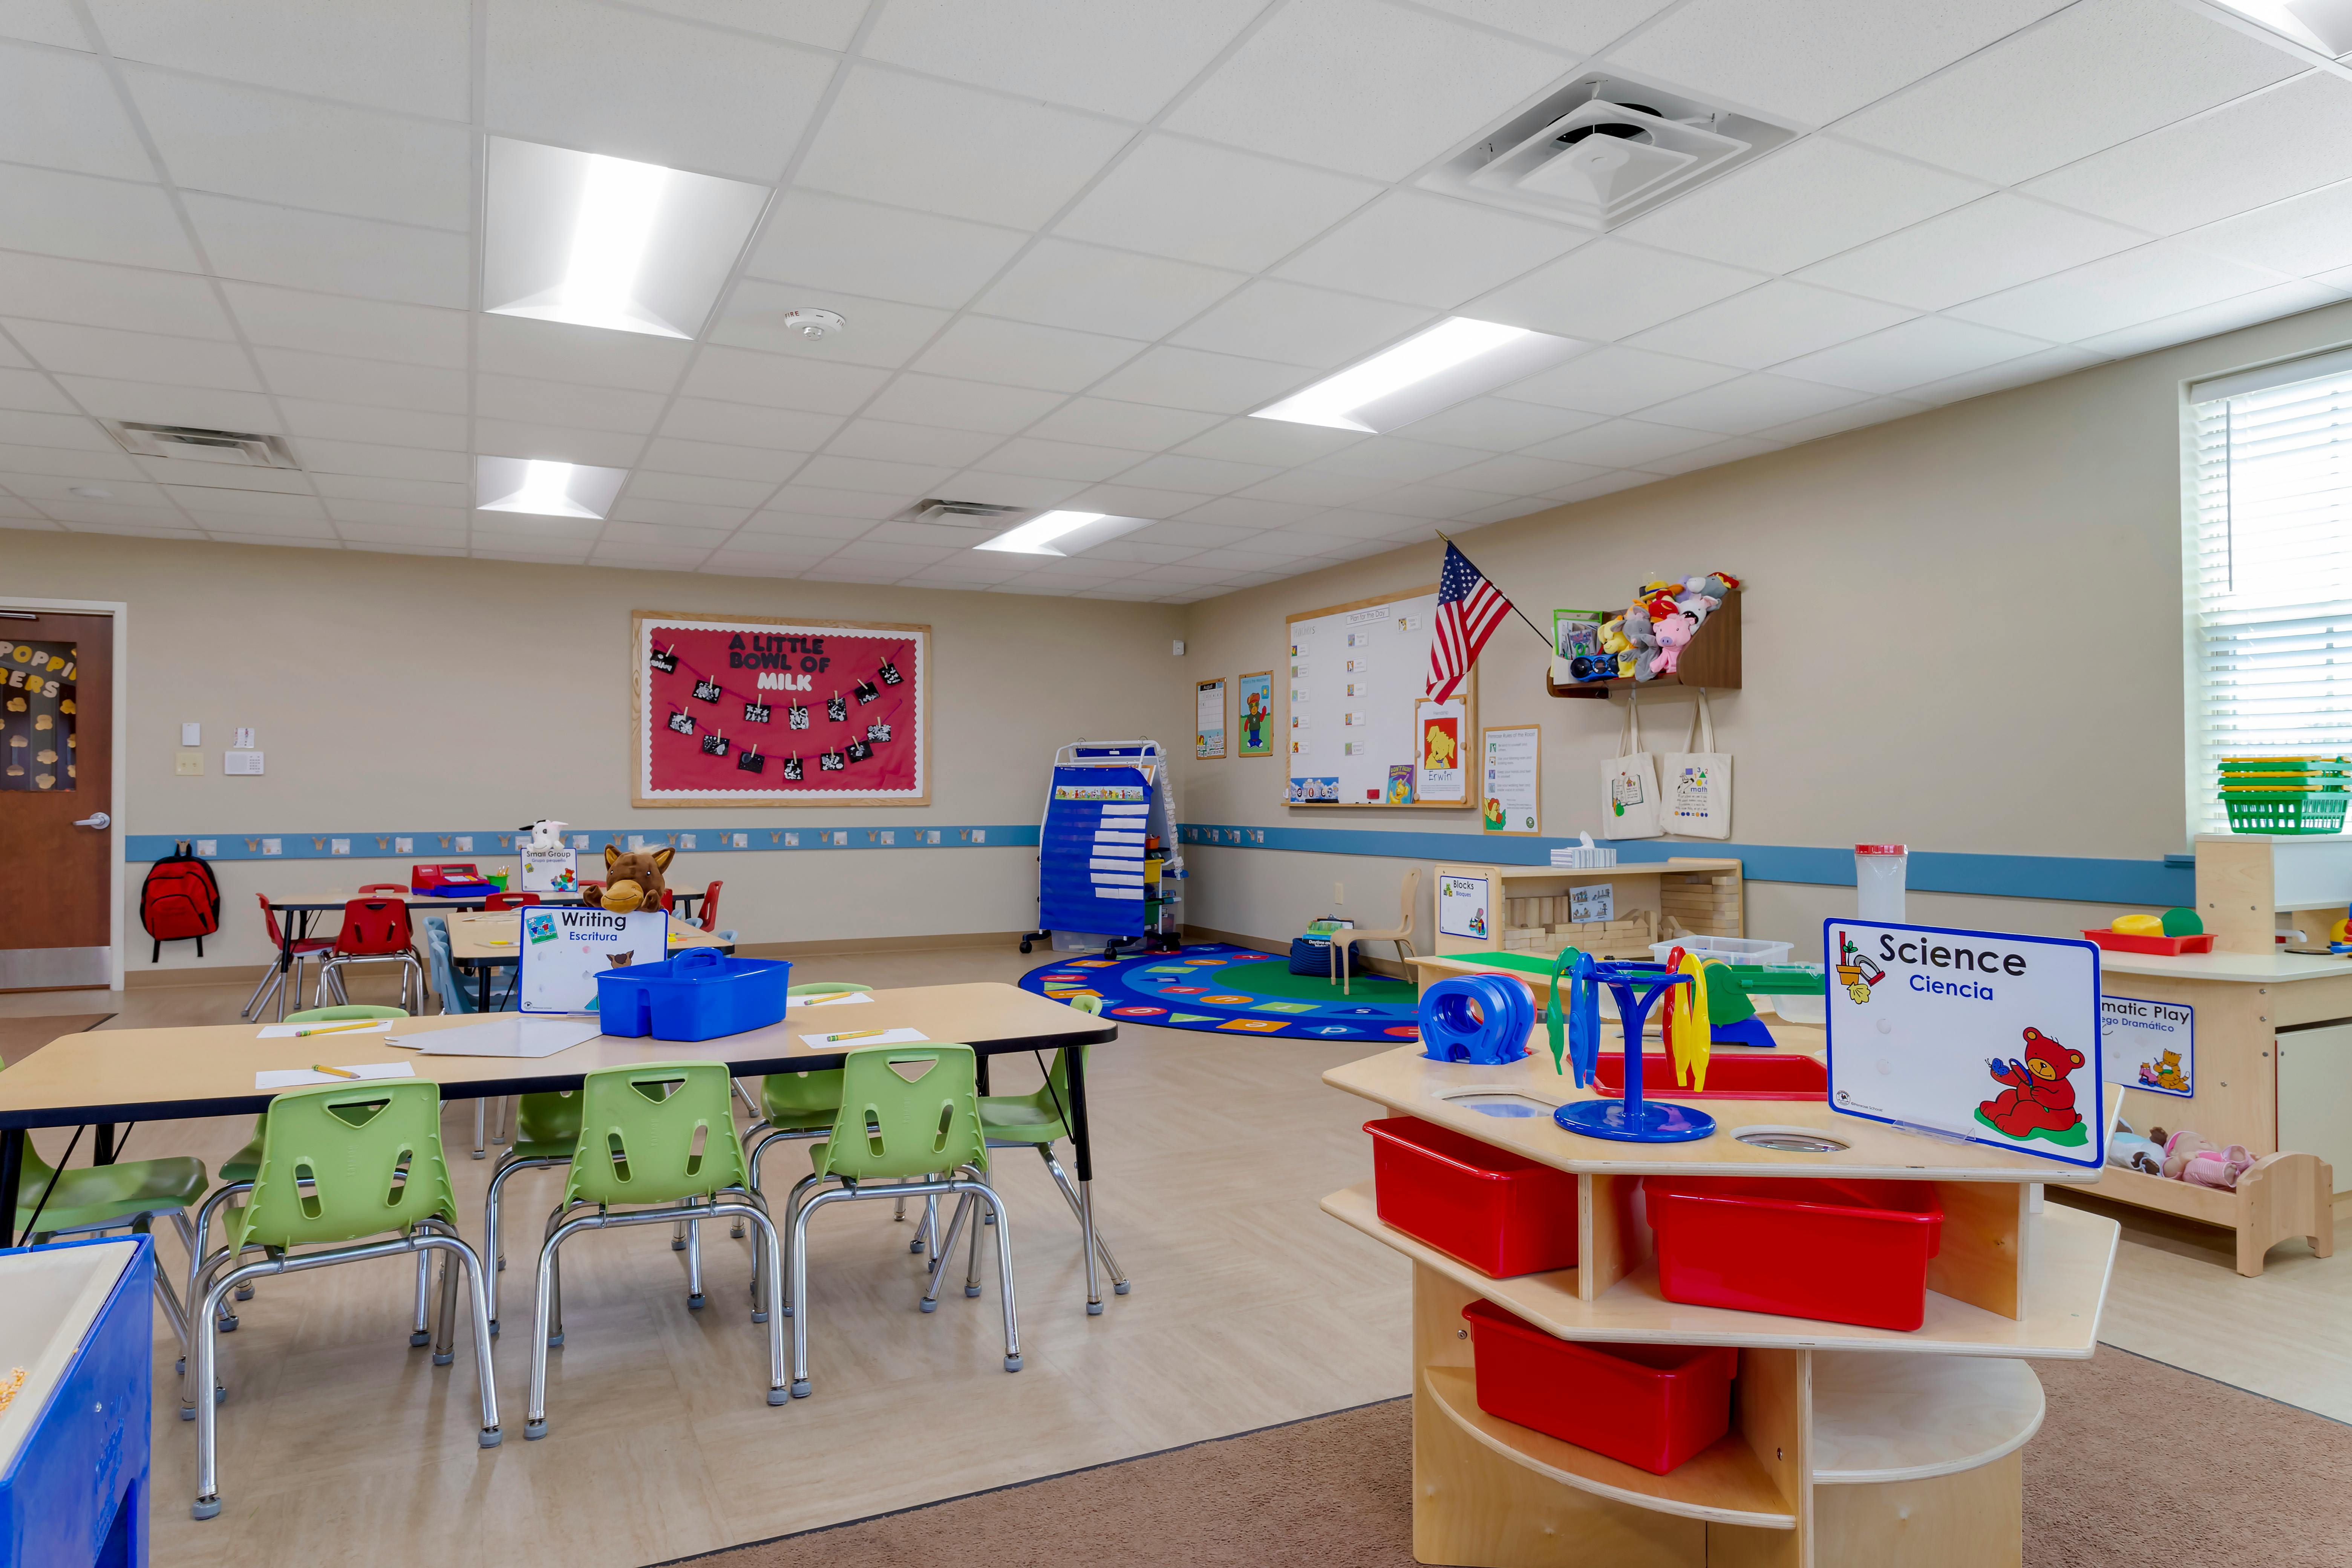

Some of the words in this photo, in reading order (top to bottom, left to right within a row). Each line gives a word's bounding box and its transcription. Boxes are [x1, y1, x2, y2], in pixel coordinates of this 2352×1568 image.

[729, 634, 746, 650] A
[753, 635, 824, 655] LITTLE
[730, 652, 792, 670] BOWL
[800, 656, 831, 673] OF
[0, 667, 60, 698] RERS
[757, 672, 812, 691] MILK
[1453, 880, 1474, 890] Blocks
[562, 912, 626, 931] Writing
[570, 932, 617, 941] Escritura
[1879, 934, 2026, 976] Science
[1909, 974, 1993, 1000] Ciencia
[2102, 1002, 2147, 1016] matic
[2154, 1006, 2190, 1024] Play
[2102, 1017, 2118, 1025] ego
[2122, 1018, 2174, 1032] Dramático
